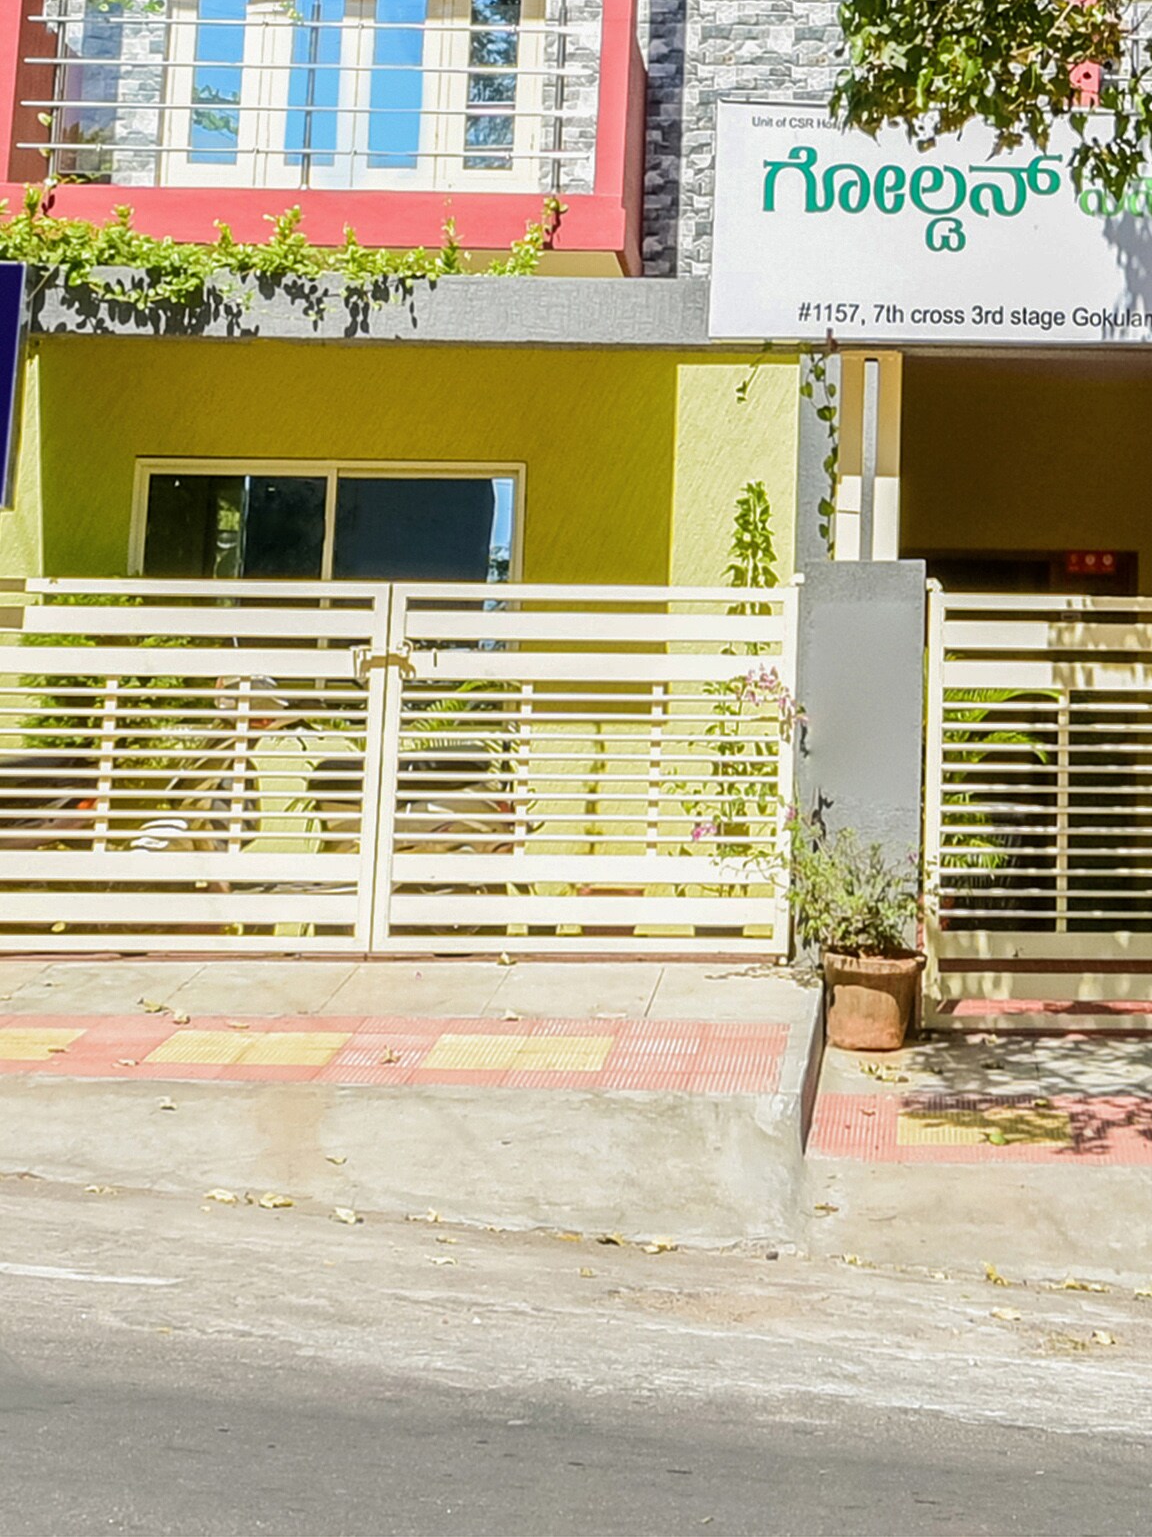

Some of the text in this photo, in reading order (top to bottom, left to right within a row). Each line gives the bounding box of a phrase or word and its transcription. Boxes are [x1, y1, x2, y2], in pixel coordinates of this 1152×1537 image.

[751, 115, 773, 128] Unit
[775, 116, 787, 128] of
[788, 116, 814, 130] CSR
[798, 301, 866, 326] #1157,
[873, 303, 905, 325] 7th
[910, 307, 966, 326] cross
[971, 304, 1004, 327] 3rd
[1009, 306, 1066, 331] stage
